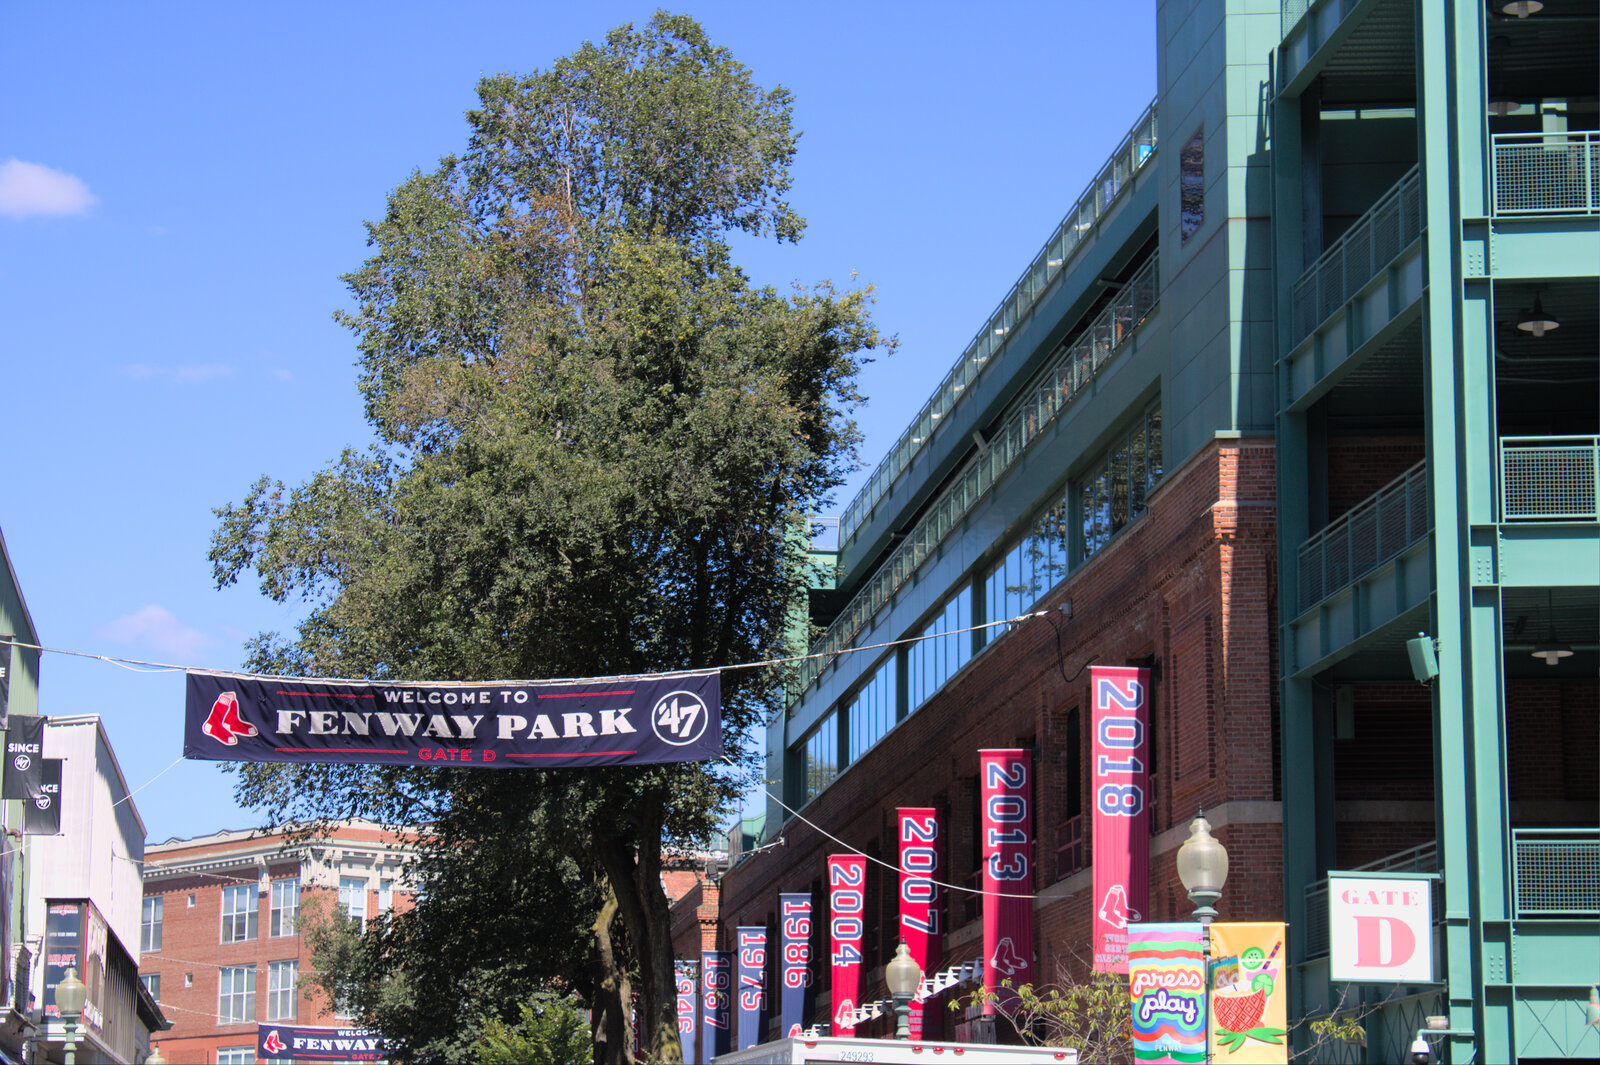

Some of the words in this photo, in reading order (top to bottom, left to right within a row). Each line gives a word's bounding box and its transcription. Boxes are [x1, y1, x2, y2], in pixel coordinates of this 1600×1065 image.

[384, 690, 491, 705] WELCOME
[501, 690, 528, 704] TO
[275, 709, 485, 739] FENWAY
[497, 708, 637, 740] PARK
[7, 743, 40, 753] SINCE
[418, 748, 472, 762] GATE
[483, 749, 497, 762] D
[1097, 678, 1144, 817] 2018
[986, 762, 1027, 881] 2013
[902, 817, 938, 934] 2007
[1341, 888, 1419, 906] GATE
[831, 864, 863, 966] 2004
[784, 901, 813, 988] 1986
[1353, 915, 1416, 968] D
[741, 933, 768, 1011] 1975
[1134, 971, 1201, 995] press
[705, 957, 730, 1030] 1967
[1140, 990, 1196, 1022] play
[293, 1037, 379, 1051] FENWAY
[841, 1050, 874, 1063] 249293
